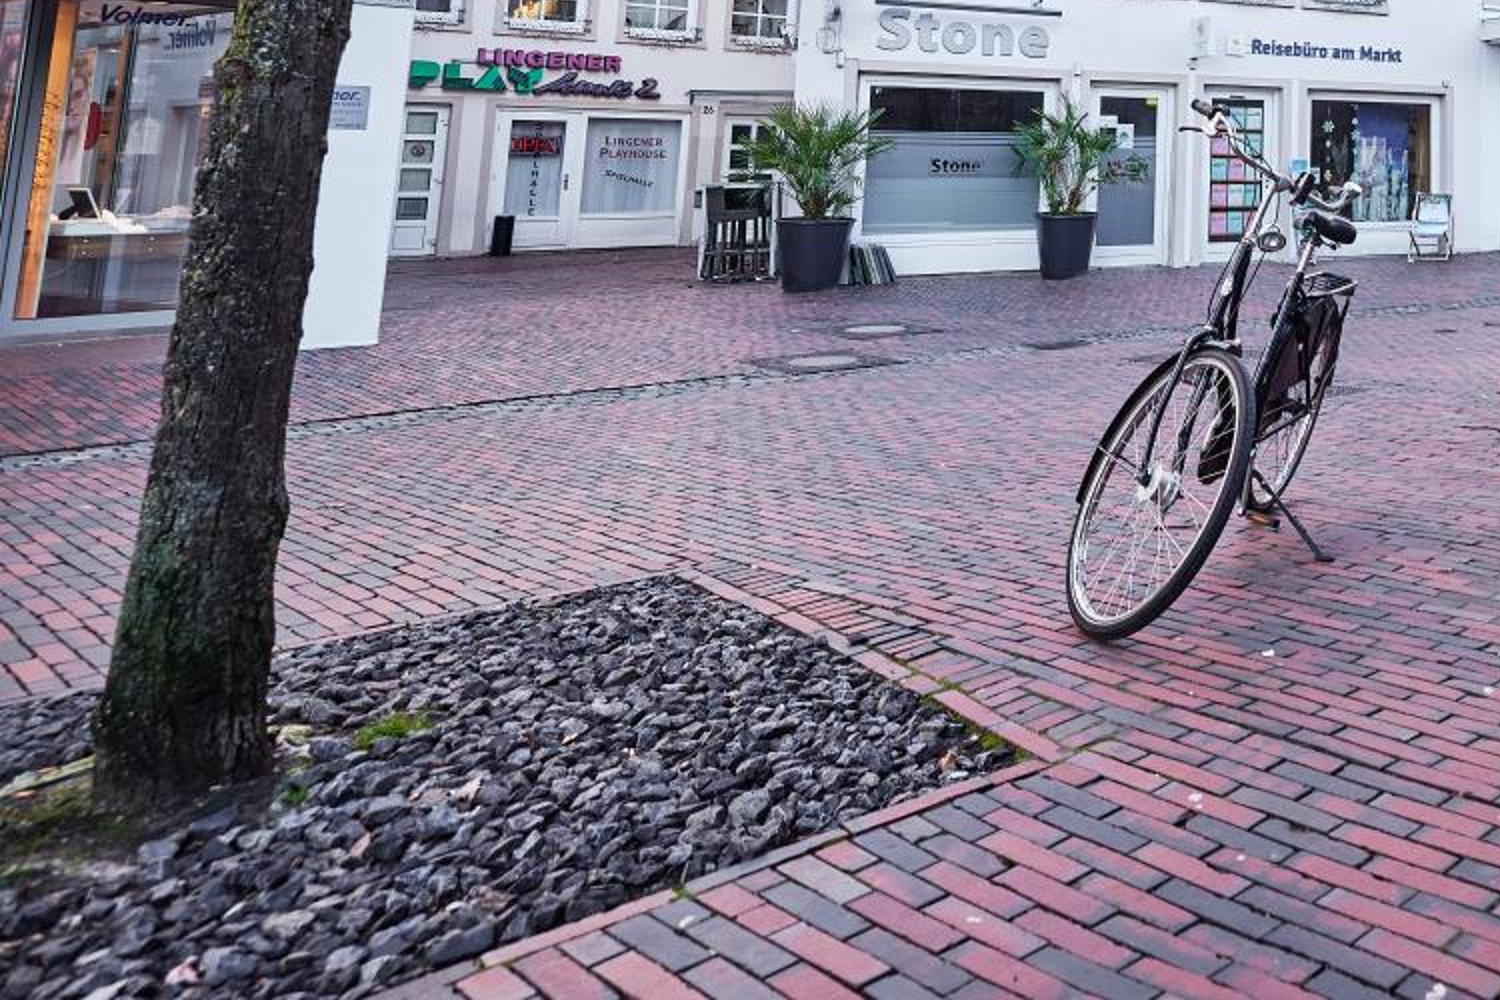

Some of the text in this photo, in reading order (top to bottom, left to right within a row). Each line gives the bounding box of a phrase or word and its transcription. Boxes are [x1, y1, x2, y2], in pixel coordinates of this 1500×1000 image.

[876, 7, 1050, 59] Stone
[477, 48, 623, 73] LINGENER
[1251, 38, 1403, 63] Reisebüro am Markt
[408, 59, 544, 95] PLAY
[634, 77, 662, 101] 2
